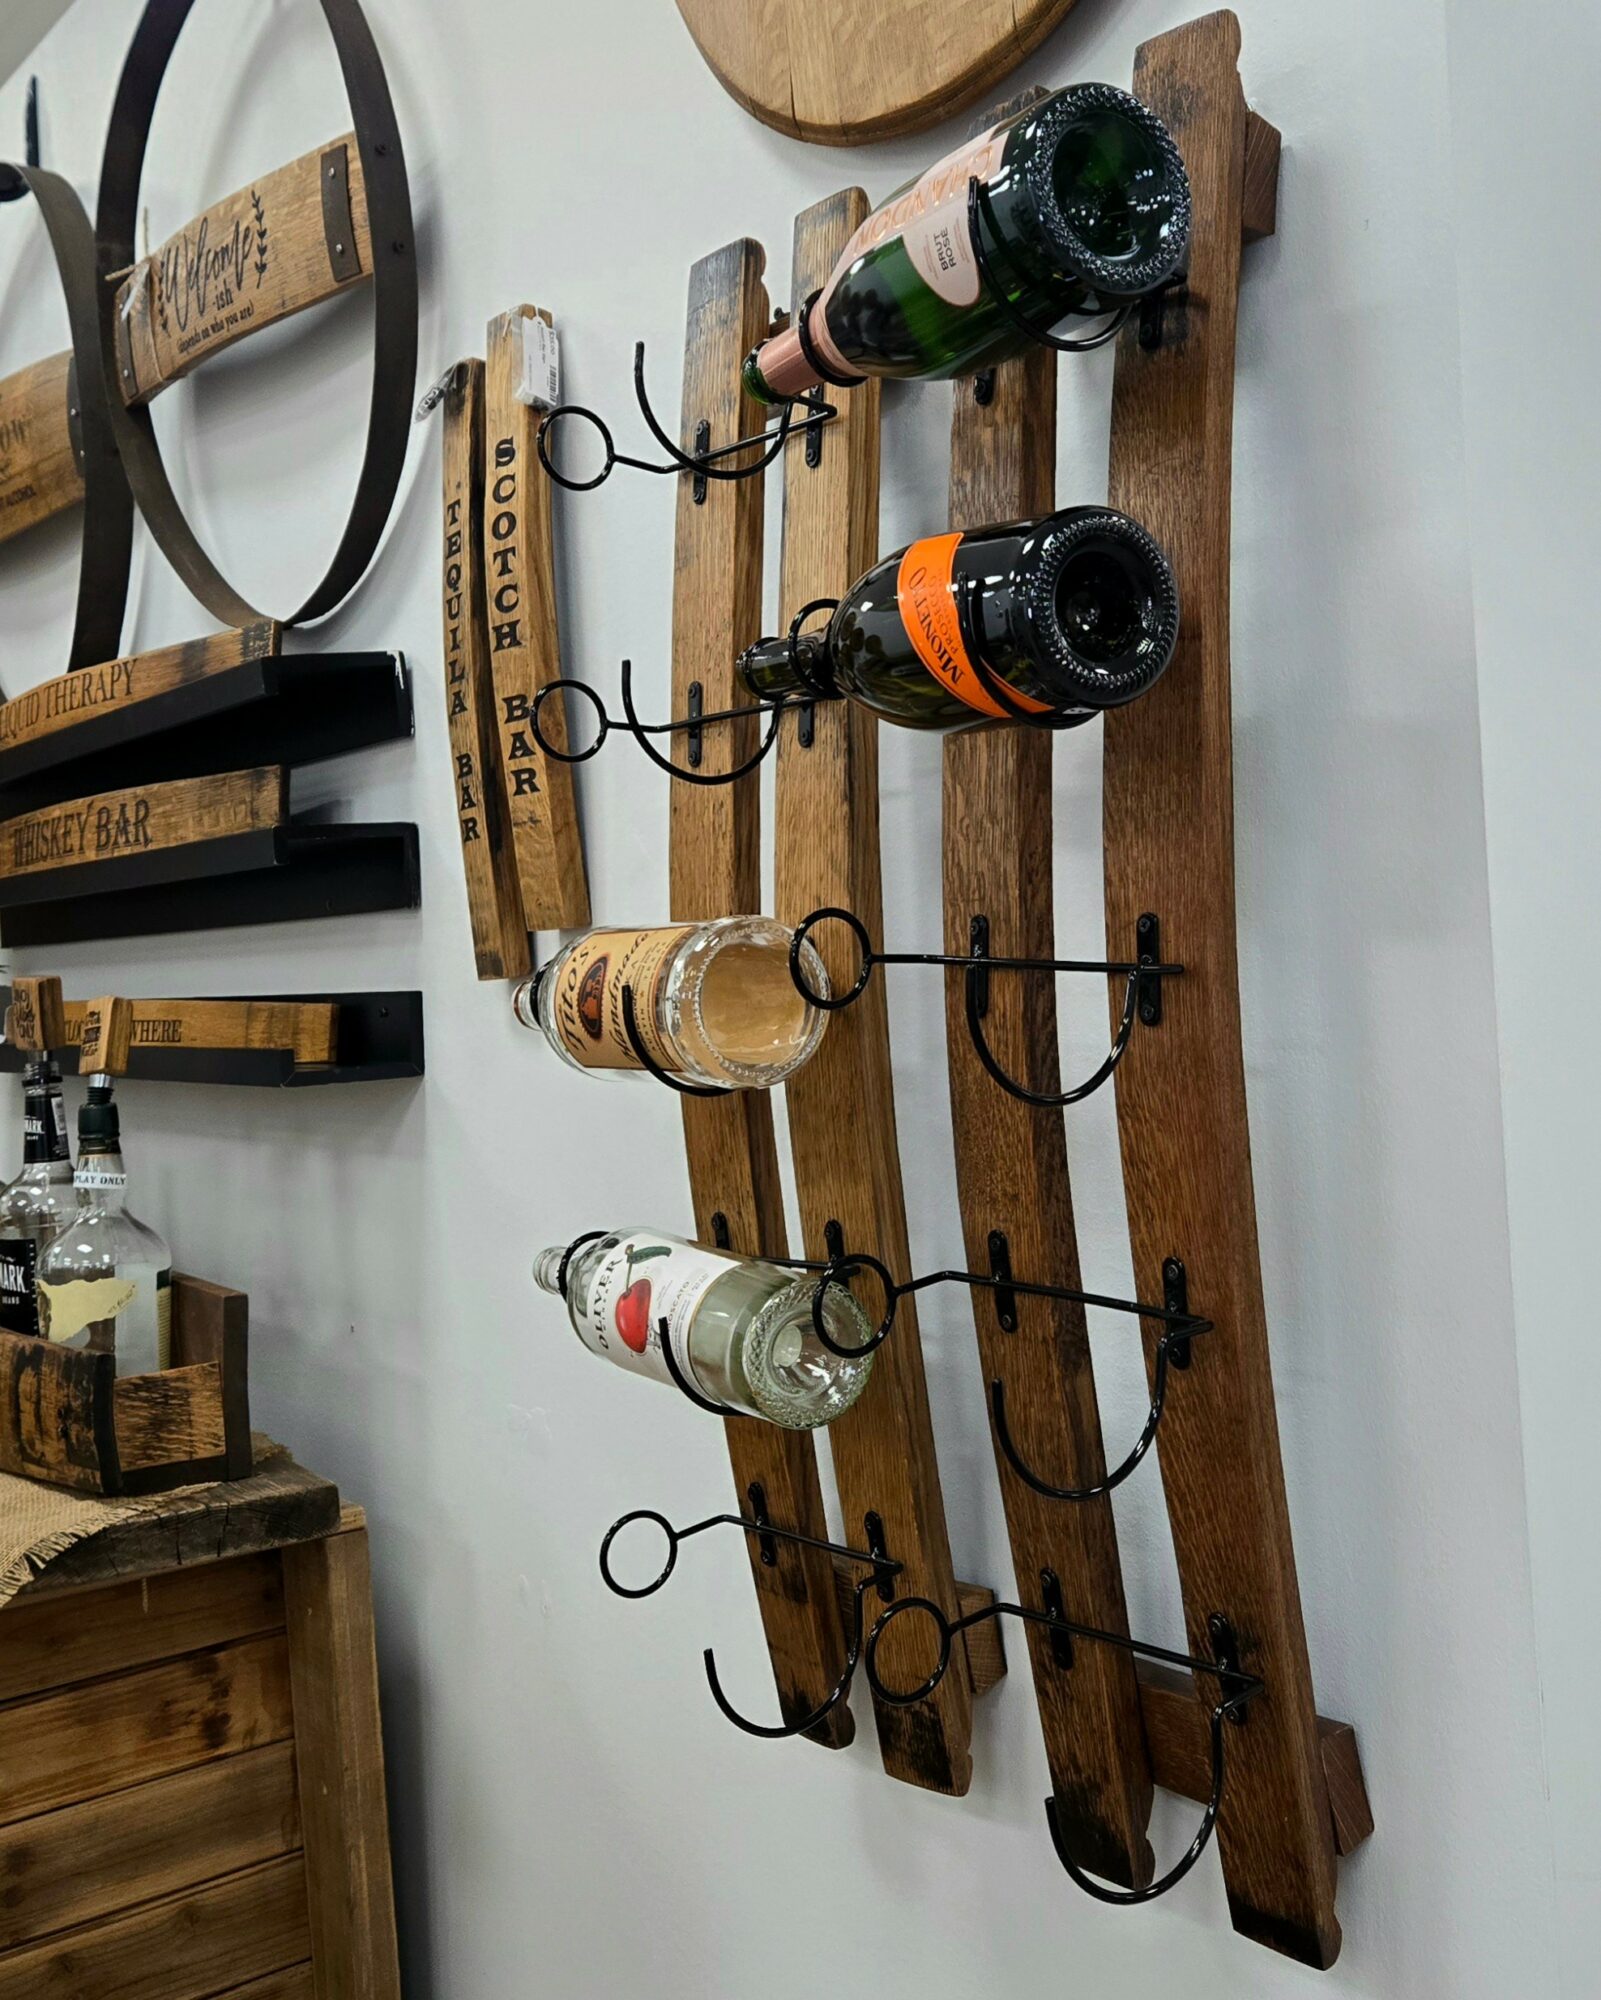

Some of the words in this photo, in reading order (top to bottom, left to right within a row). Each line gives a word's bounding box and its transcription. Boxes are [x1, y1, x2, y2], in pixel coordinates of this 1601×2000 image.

[164, 216, 255, 332] Welcome
[933, 233, 949, 271] BRUT
[492, 436, 523, 653] SCOTCH
[446, 498, 468, 717] TEQUILA
[908, 566, 965, 685] MIONETTO
[43, 658, 138, 720] THERAPY
[502, 693, 541, 797] BAR
[14, 800, 95, 868] WHISKEY
[96, 799, 152, 852] BAR
[456, 752, 481, 844] BAR
[99, 1175, 126, 1186] ONLY
[593, 1257, 624, 1350] OLIVER
